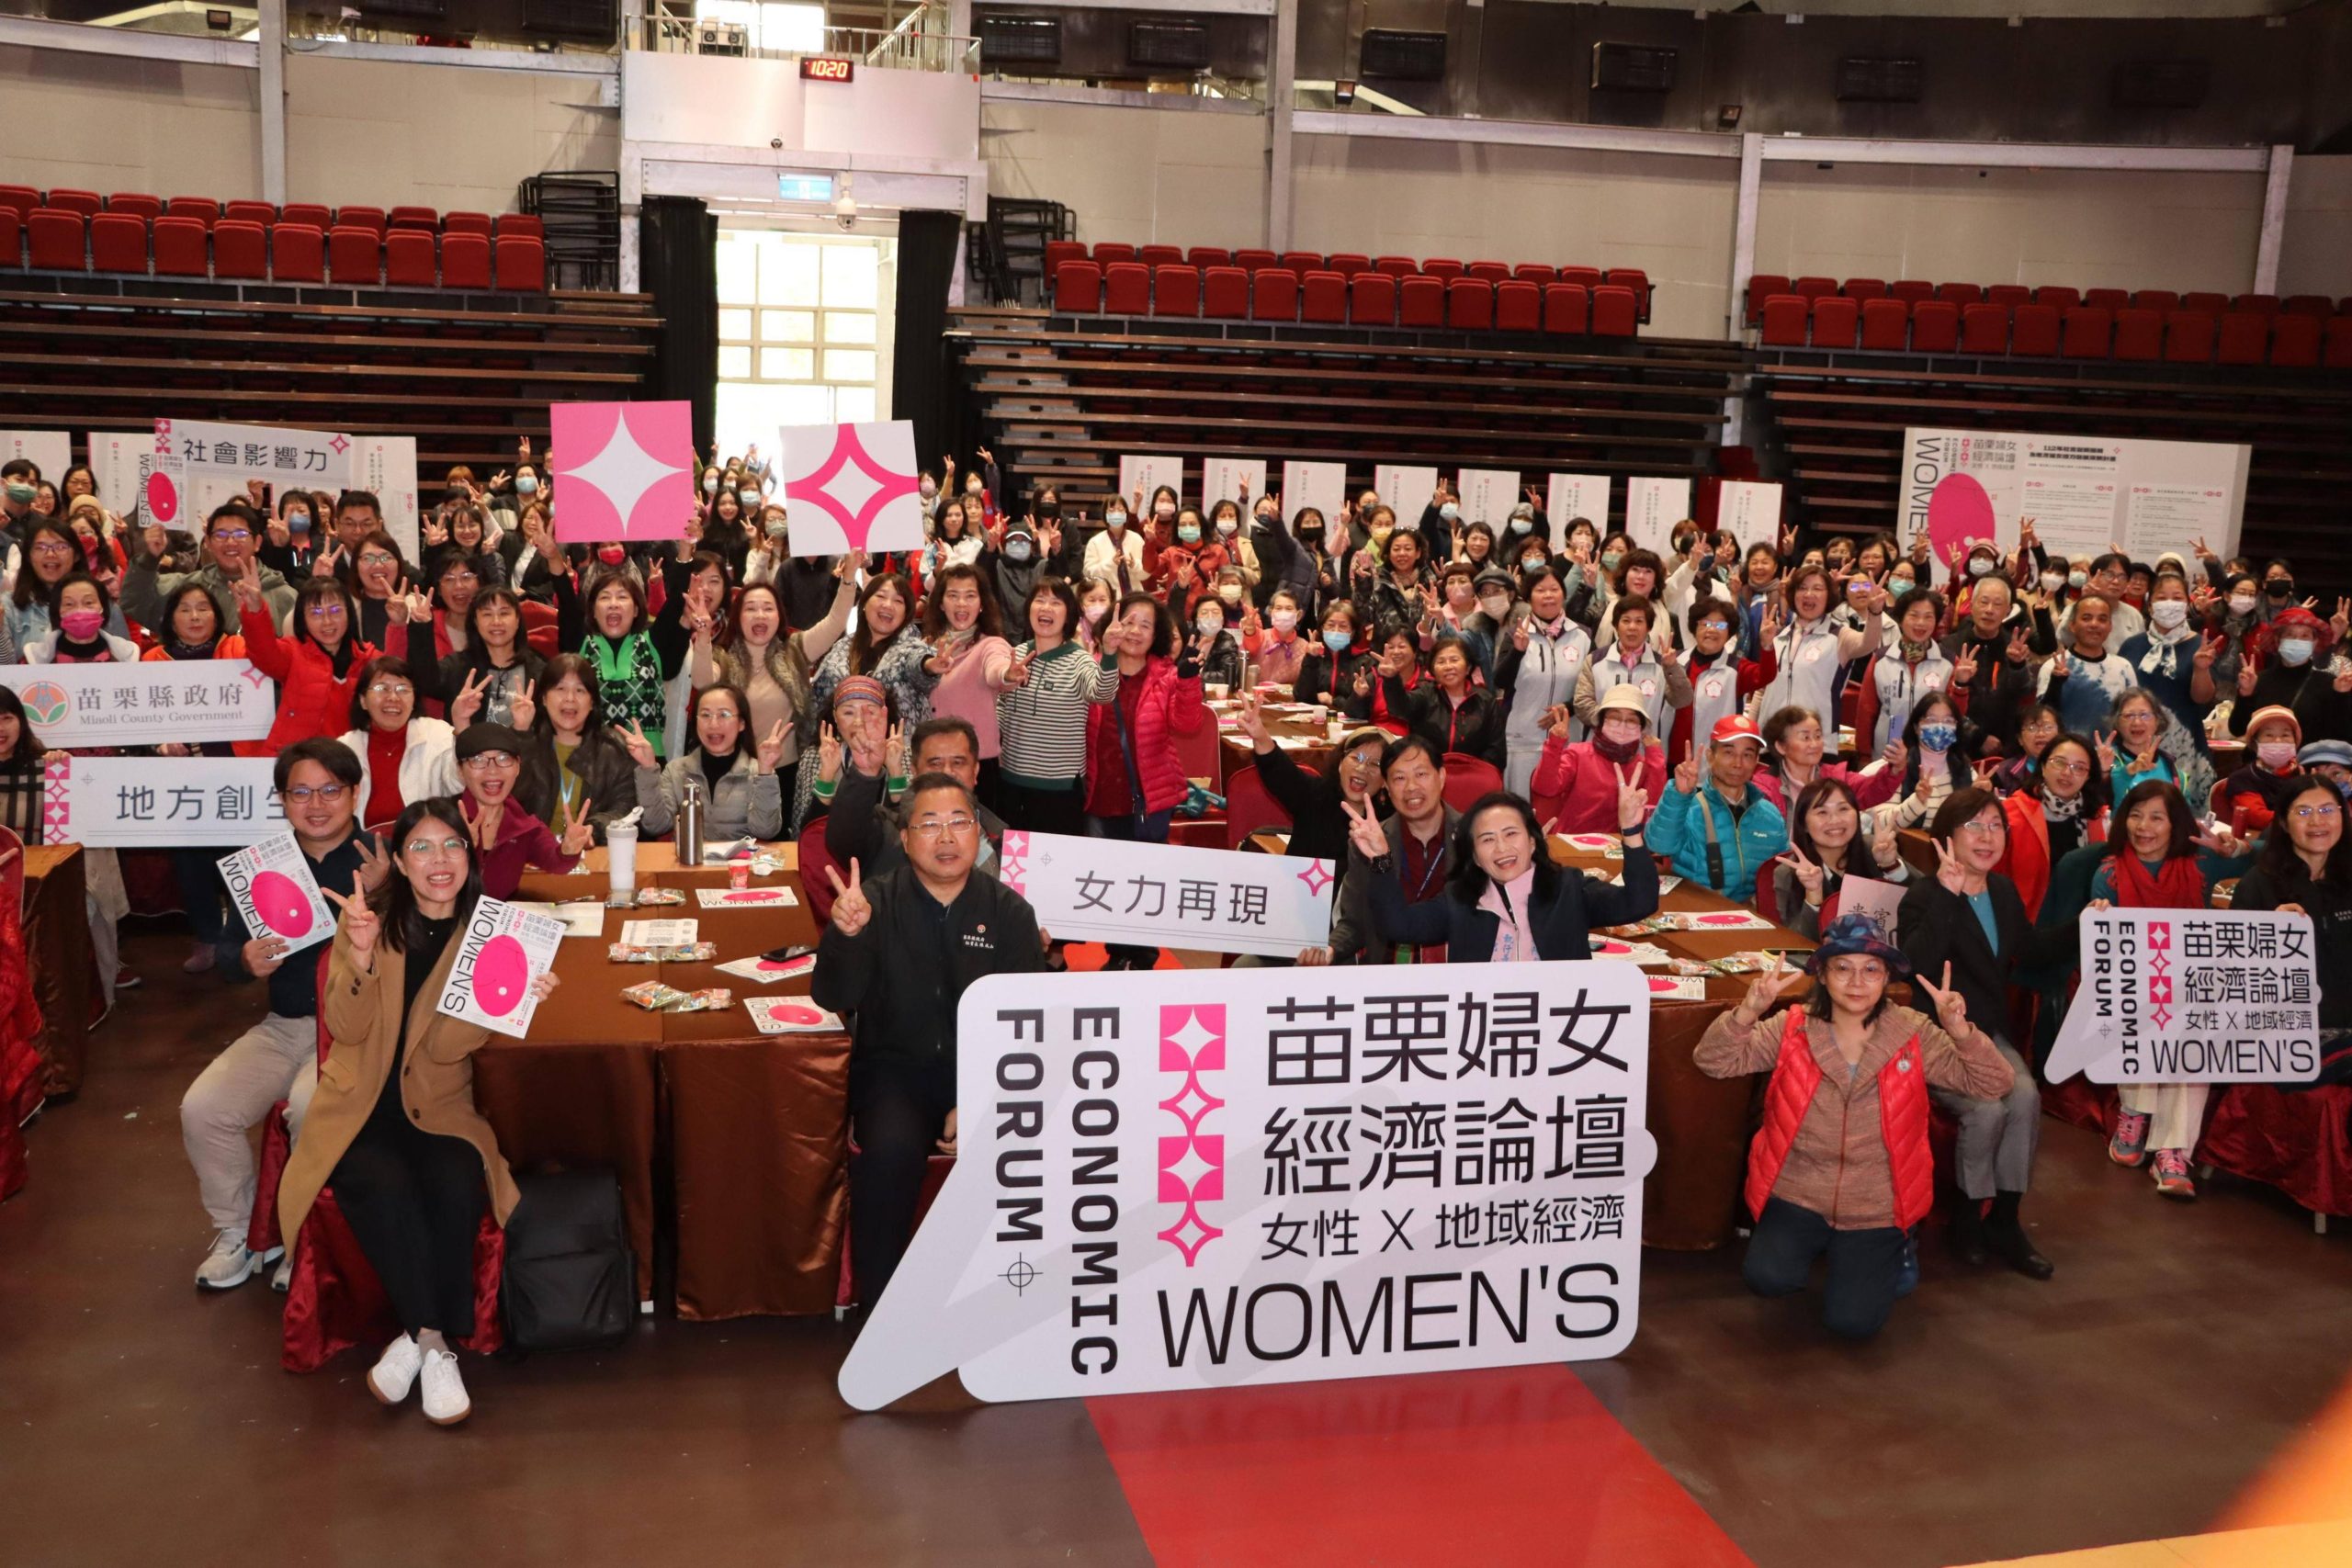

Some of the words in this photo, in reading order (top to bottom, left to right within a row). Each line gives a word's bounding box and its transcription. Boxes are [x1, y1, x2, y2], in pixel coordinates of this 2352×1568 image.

[184, 438, 327, 471] 社會影響力
[140, 454, 150, 525] WOMEN'S
[75, 682, 244, 712] 苗栗縣政府
[80, 714, 117, 726] Miaoli
[121, 712, 164, 726] County
[168, 709, 243, 722] Government
[1073, 869, 1269, 926] 女力再現
[444, 900, 503, 1012] WOMEN'S
[2093, 920, 2111, 1017] FORUM
[2183, 919, 2310, 959] 苗栗婦女
[2119, 920, 2139, 1075] ECONOMIC
[2185, 965, 2312, 1004] 經濟論壇
[1266, 987, 1632, 1087] 苗栗婦女
[2186, 1010, 2219, 1031] 女性
[2245, 1010, 2312, 1031] 地域經濟
[2151, 1040, 2314, 1074] WOMEN'S
[996, 1008, 1045, 1243] FORUM
[1263, 1093, 1627, 1197] 經濟論壇
[1071, 1007, 1120, 1376] ECONOMIC
[1261, 1208, 1360, 1261] 女性
[1434, 1194, 1625, 1251] 地域經濟
[1157, 1262, 1621, 1368] WOMEN'S
